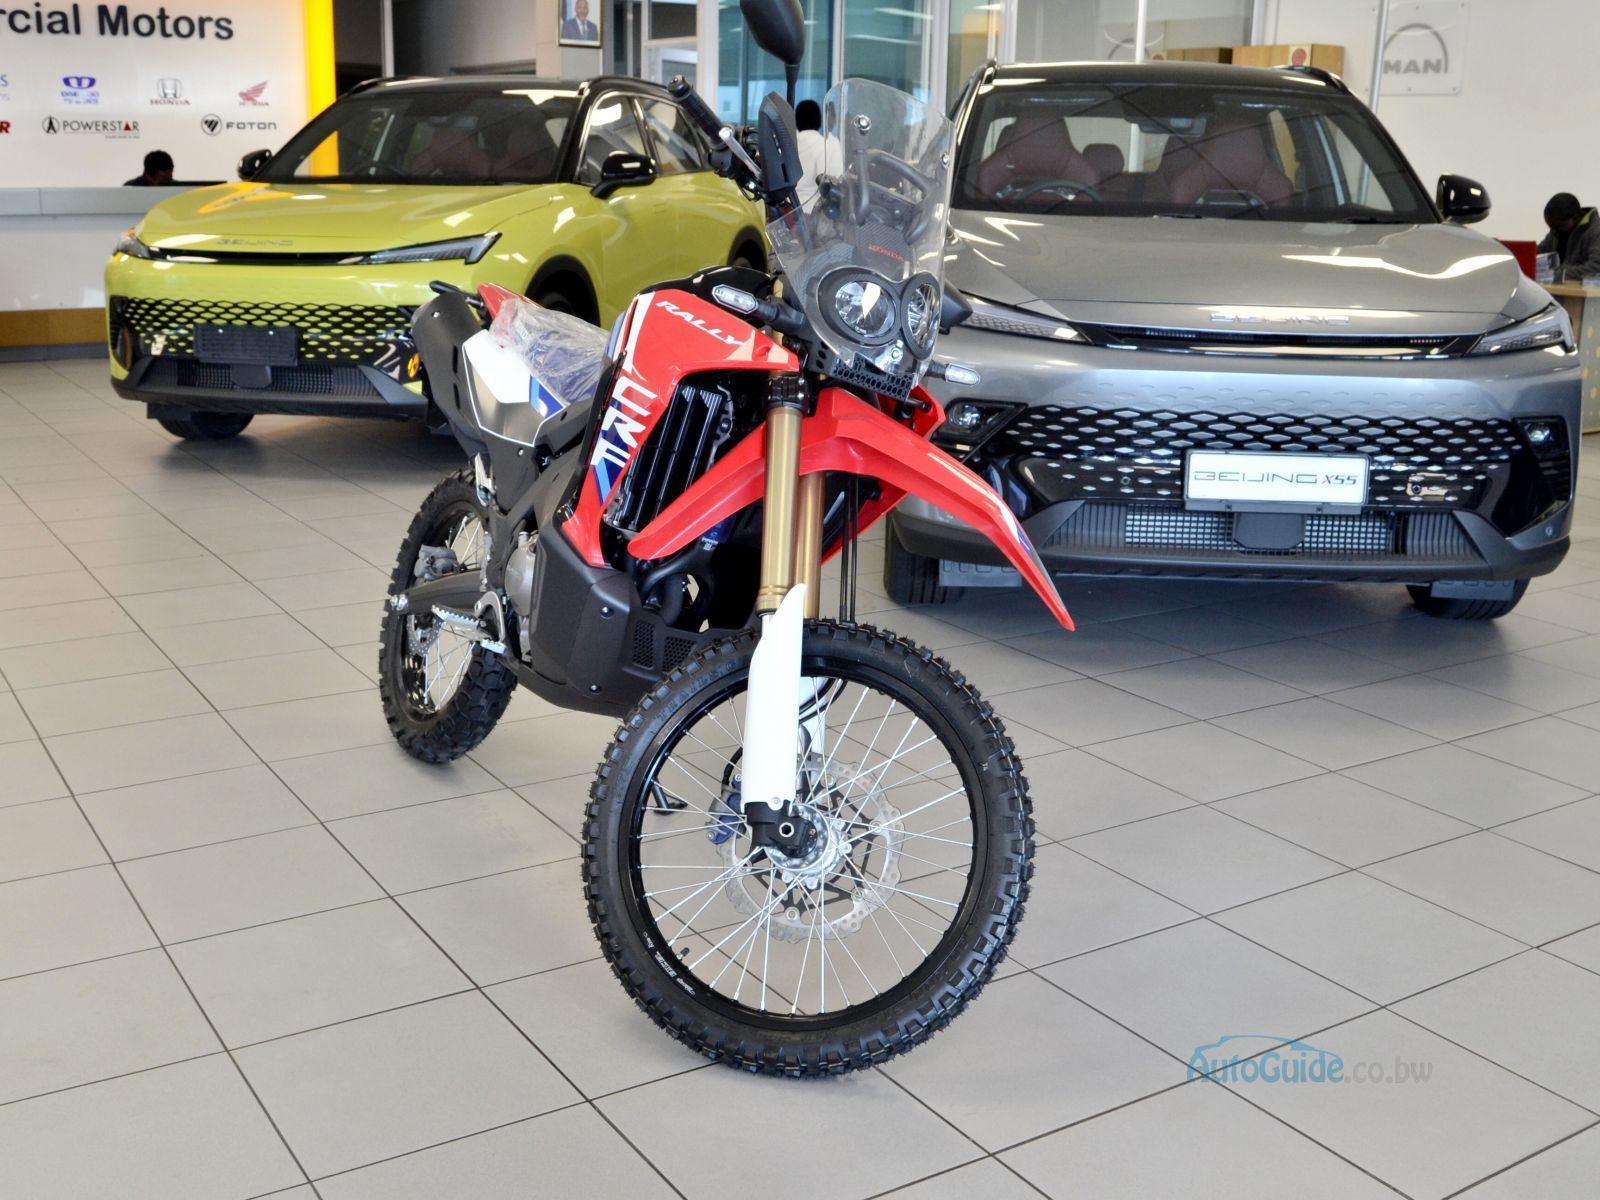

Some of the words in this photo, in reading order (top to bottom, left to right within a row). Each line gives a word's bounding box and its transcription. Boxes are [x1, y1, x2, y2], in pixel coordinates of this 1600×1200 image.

[97, 4, 234, 40] Motors
[1383, 59, 1443, 74] MAN
[62, 119, 140, 132] POWERSTAR
[226, 122, 278, 131] FOTON
[655, 300, 748, 346] RALLY
[590, 375, 659, 469] CRF
[1194, 470, 1318, 484] BEIJING
[1321, 474, 1358, 486] X55
